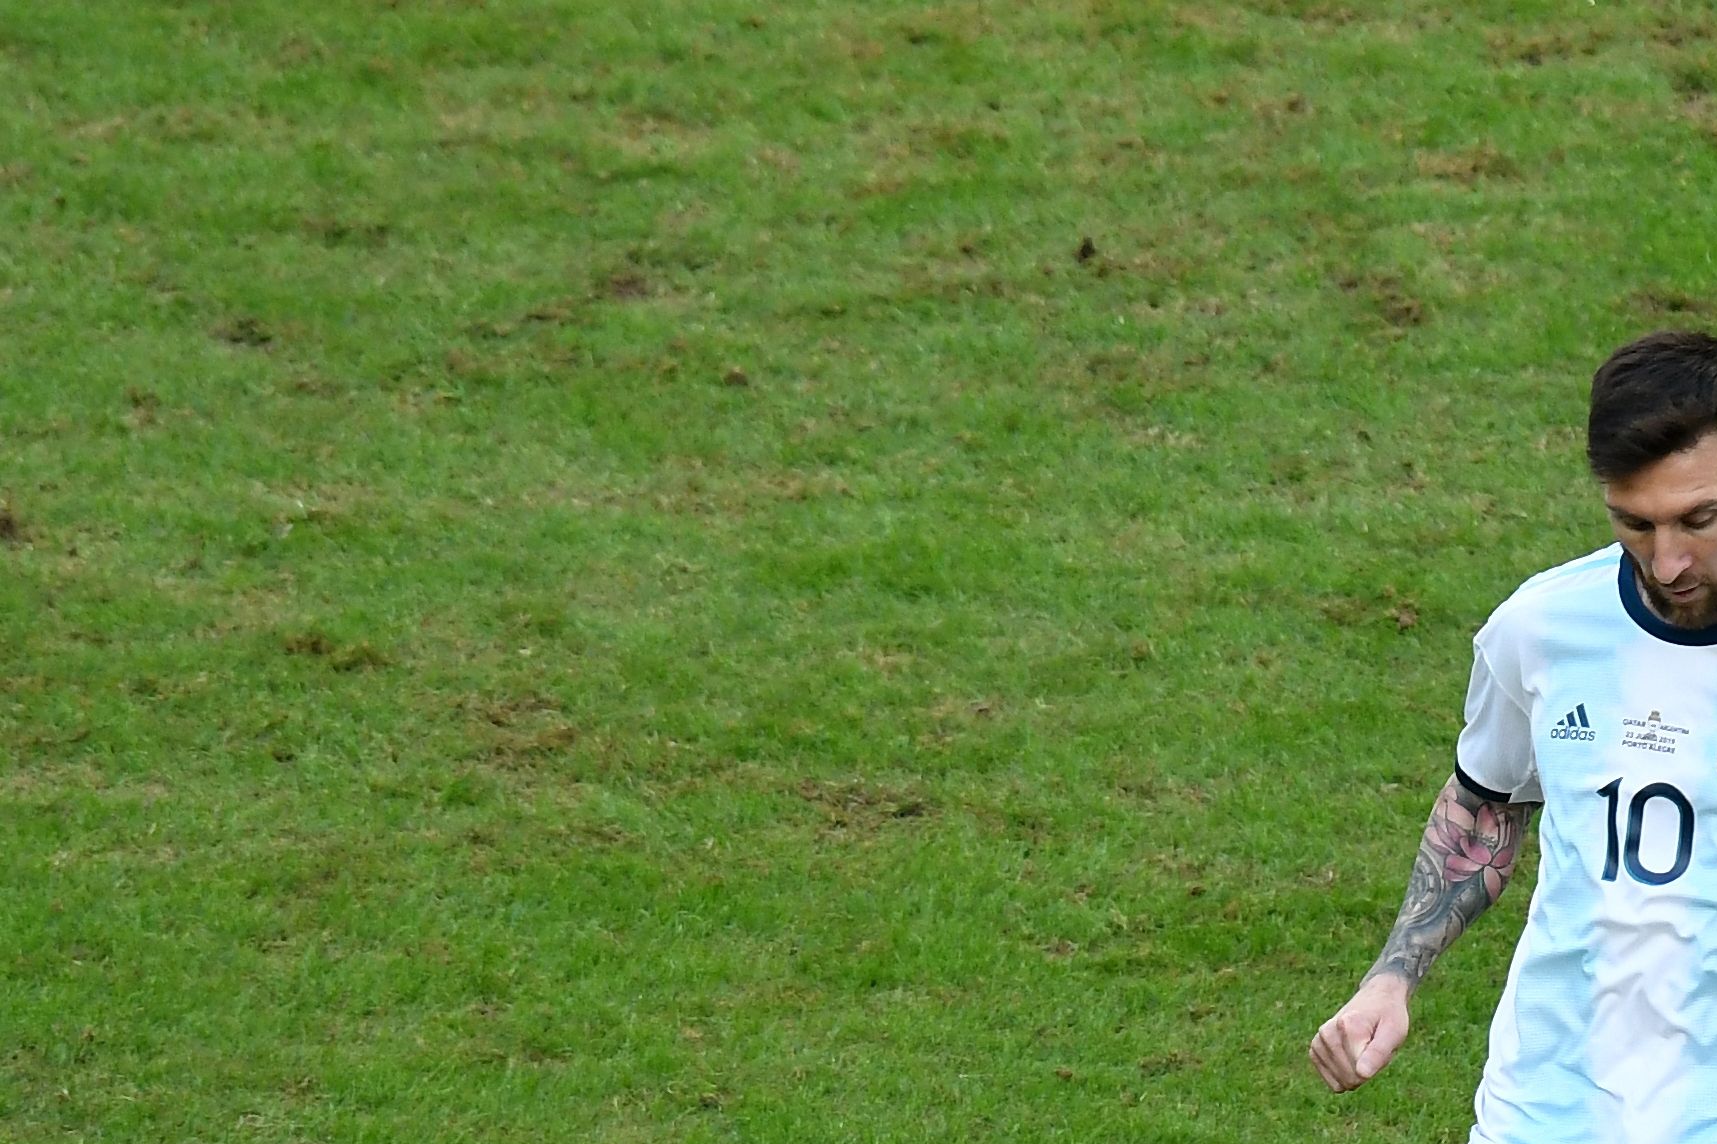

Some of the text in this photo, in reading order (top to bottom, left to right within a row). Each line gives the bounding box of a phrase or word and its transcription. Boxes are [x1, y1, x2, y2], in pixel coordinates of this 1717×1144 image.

[1622, 718, 1646, 728] QATAR
[1550, 725, 1596, 741] adidas
[1621, 739, 1676, 754] PORTO ALEGRE
[1595, 776, 1695, 887] 10
